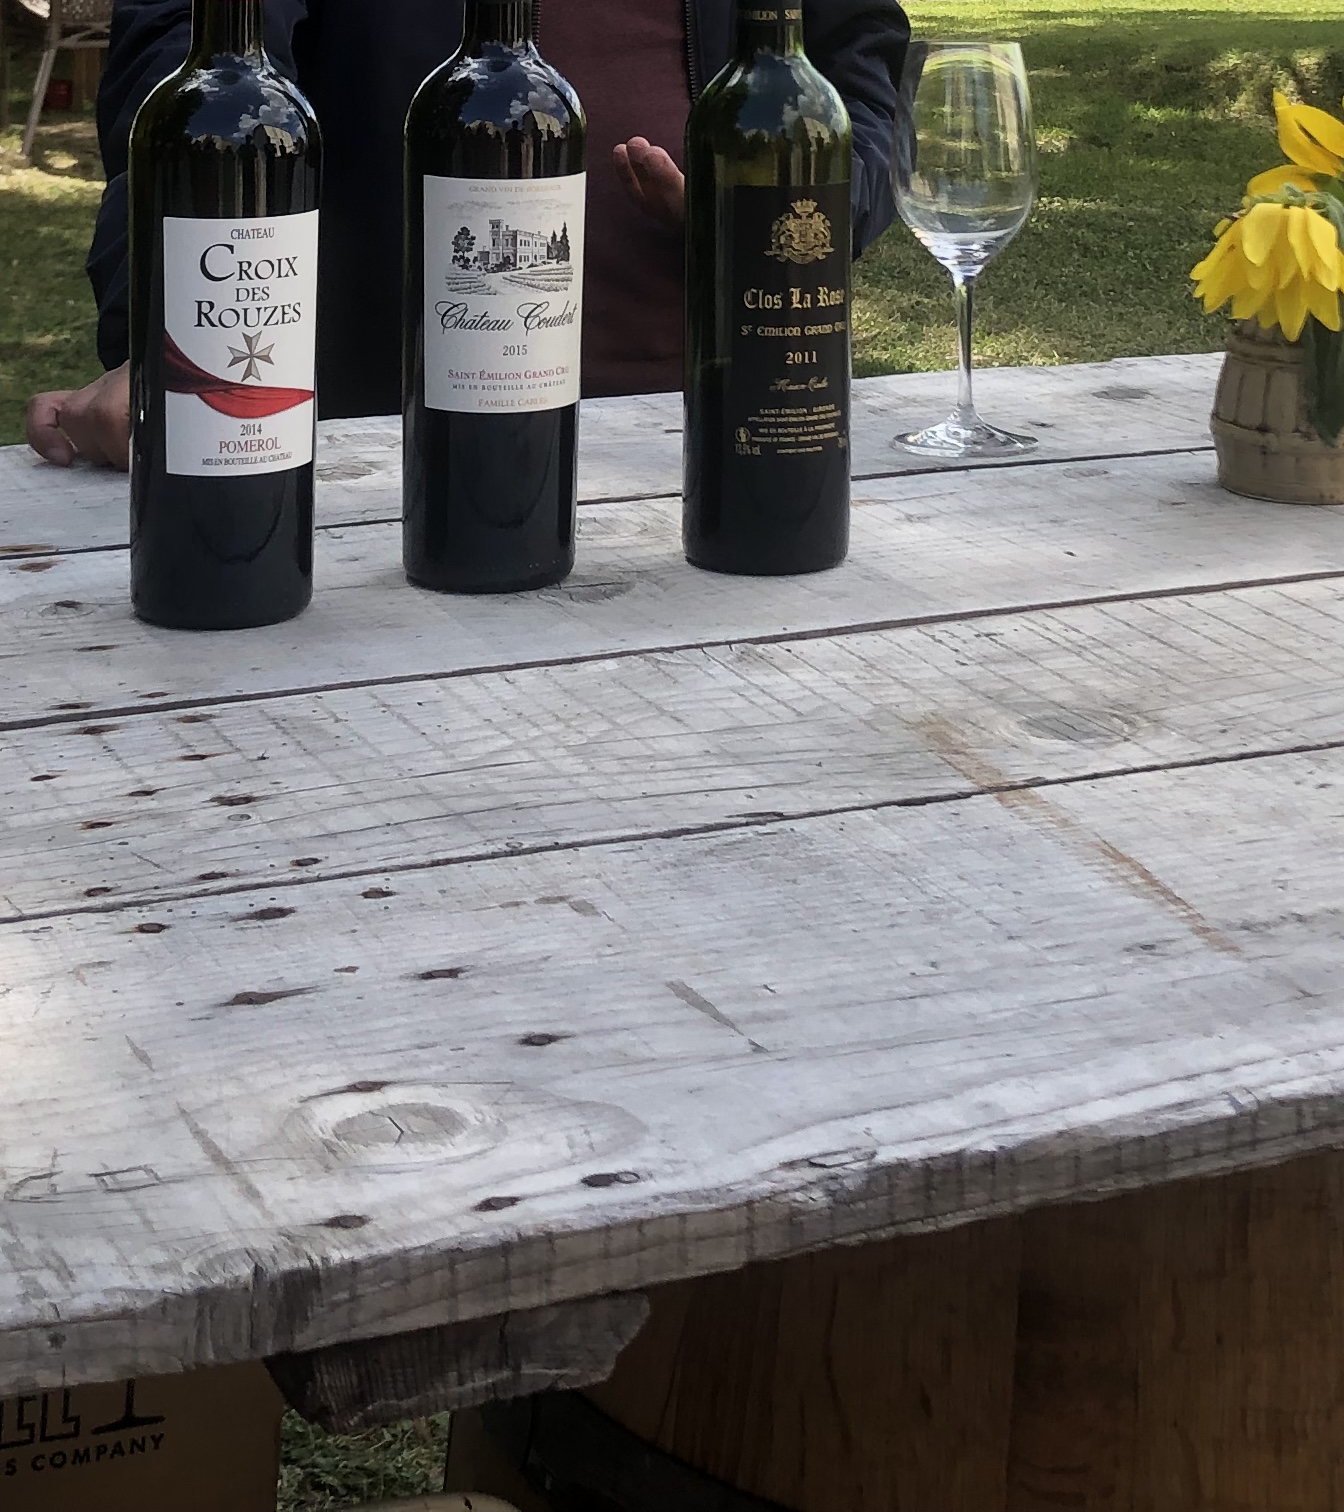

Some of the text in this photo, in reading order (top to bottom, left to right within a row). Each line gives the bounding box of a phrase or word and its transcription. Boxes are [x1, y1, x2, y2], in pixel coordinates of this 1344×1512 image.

[230, 227, 275, 240] CHATEAU
[199, 243, 299, 282] CROIX
[235, 286, 271, 303] DES
[743, 287, 783, 309] Clos
[788, 287, 812, 309] La
[194, 299, 302, 329] ROUZES
[502, 344, 528, 357] 2015
[785, 350, 818, 364] 2011
[447, 368, 476, 380] SAINT
[524, 369, 555, 380] GRAND
[478, 398, 514, 407] FAMILLE
[239, 424, 262, 437] 2014
[218, 437, 282, 454] POMEROL
[31, 1432, 166, 1472] COMPANY
